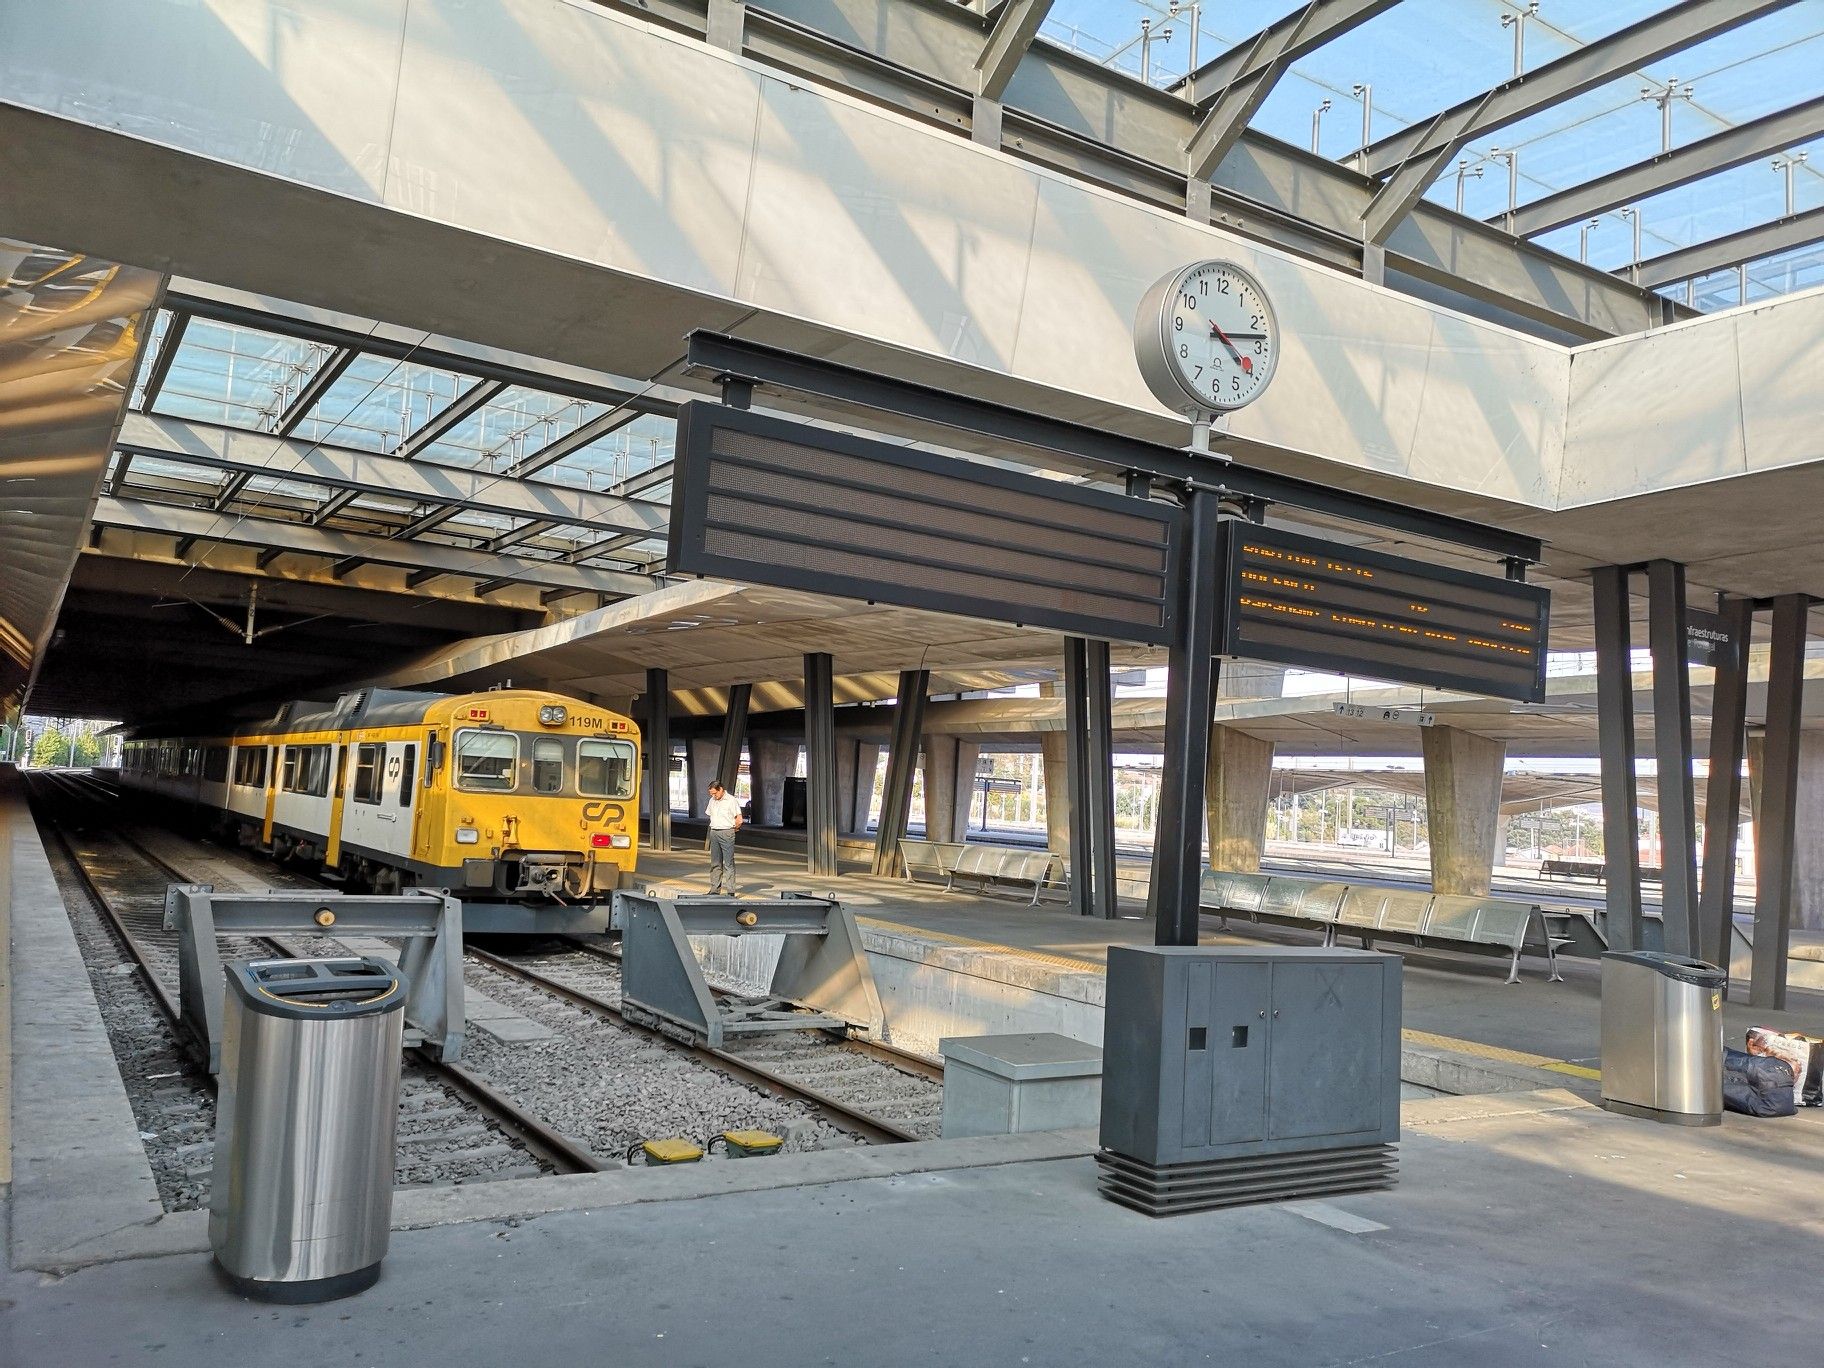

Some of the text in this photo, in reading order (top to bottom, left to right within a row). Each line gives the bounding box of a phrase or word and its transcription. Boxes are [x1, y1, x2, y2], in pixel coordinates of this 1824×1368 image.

[1199, 280, 1208, 296] 11
[1217, 278, 1229, 295] 12
[1183, 293, 1197, 310] 10
[1239, 293, 1244, 308] 1
[1175, 316, 1184, 331] 9
[1250, 315, 1259, 330] 2
[1180, 343, 1188, 359] 8
[1254, 340, 1262, 354] 3
[1194, 365, 1203, 380] 7
[1212, 378, 1220, 393] 6
[1231, 376, 1240, 391] 5
[569, 716, 603, 729] 119M
[582, 802, 625, 828] CP
